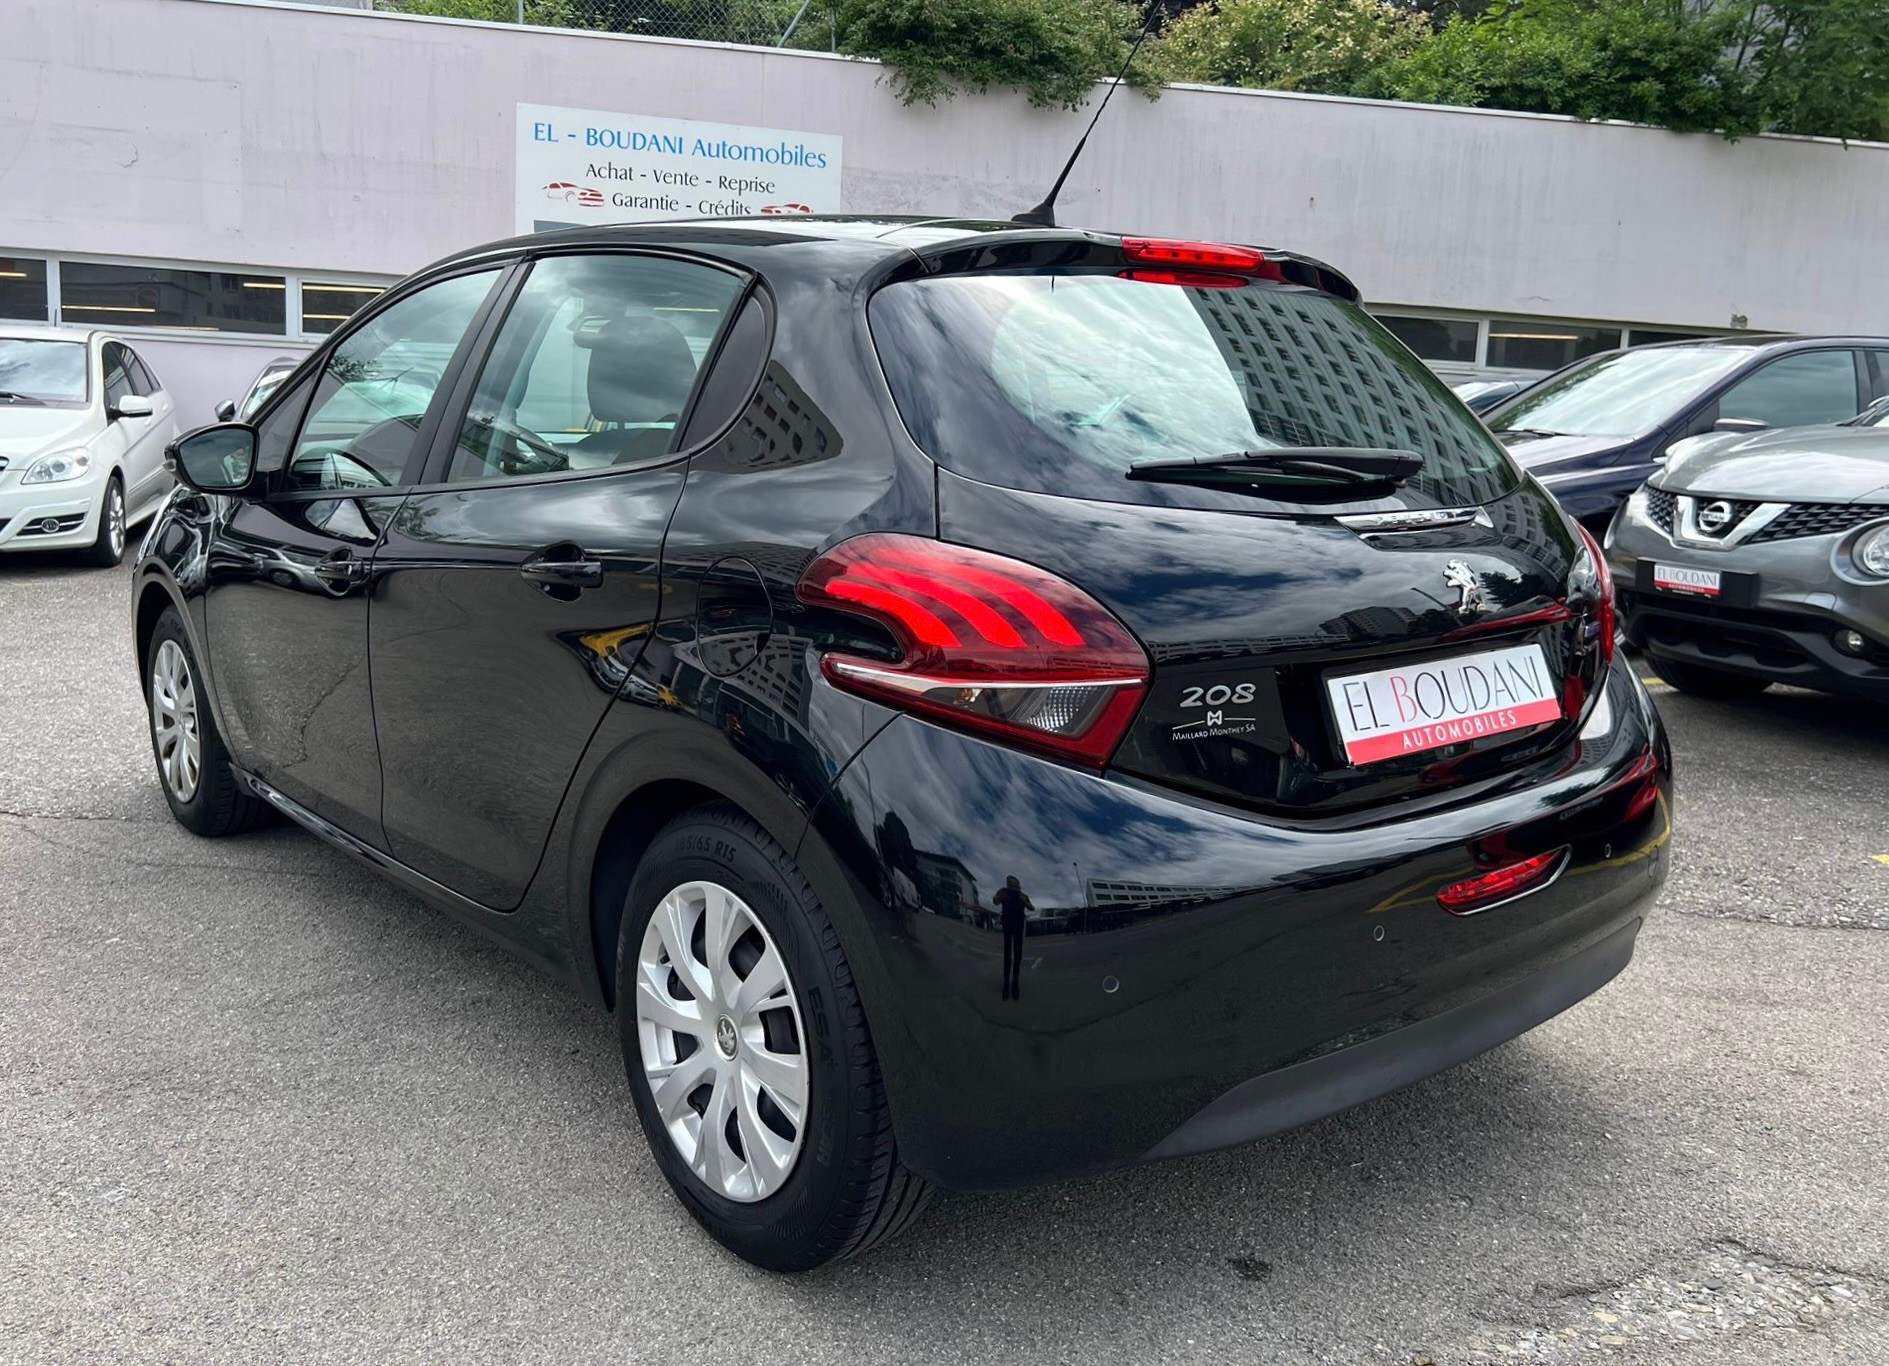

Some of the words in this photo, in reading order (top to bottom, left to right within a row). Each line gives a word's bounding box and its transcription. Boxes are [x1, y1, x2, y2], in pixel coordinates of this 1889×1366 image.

[534, 122, 559, 143] EL
[586, 128, 684, 155] BOUDANI
[692, 138, 828, 169] Automobiles
[585, 162, 634, 181] Achat
[653, 169, 699, 188] Vente
[718, 175, 776, 195] Reprise
[612, 192, 680, 212] Garantie
[698, 199, 751, 216] Crédits
[1179, 683, 1256, 708] 208
[1343, 681, 1390, 731] EL
[1390, 655, 1544, 723] BOUDANI
[1246, 723, 1256, 733] SA
[1403, 710, 1518, 750] AUTOMOBILES
[714, 840, 737, 862] R15
